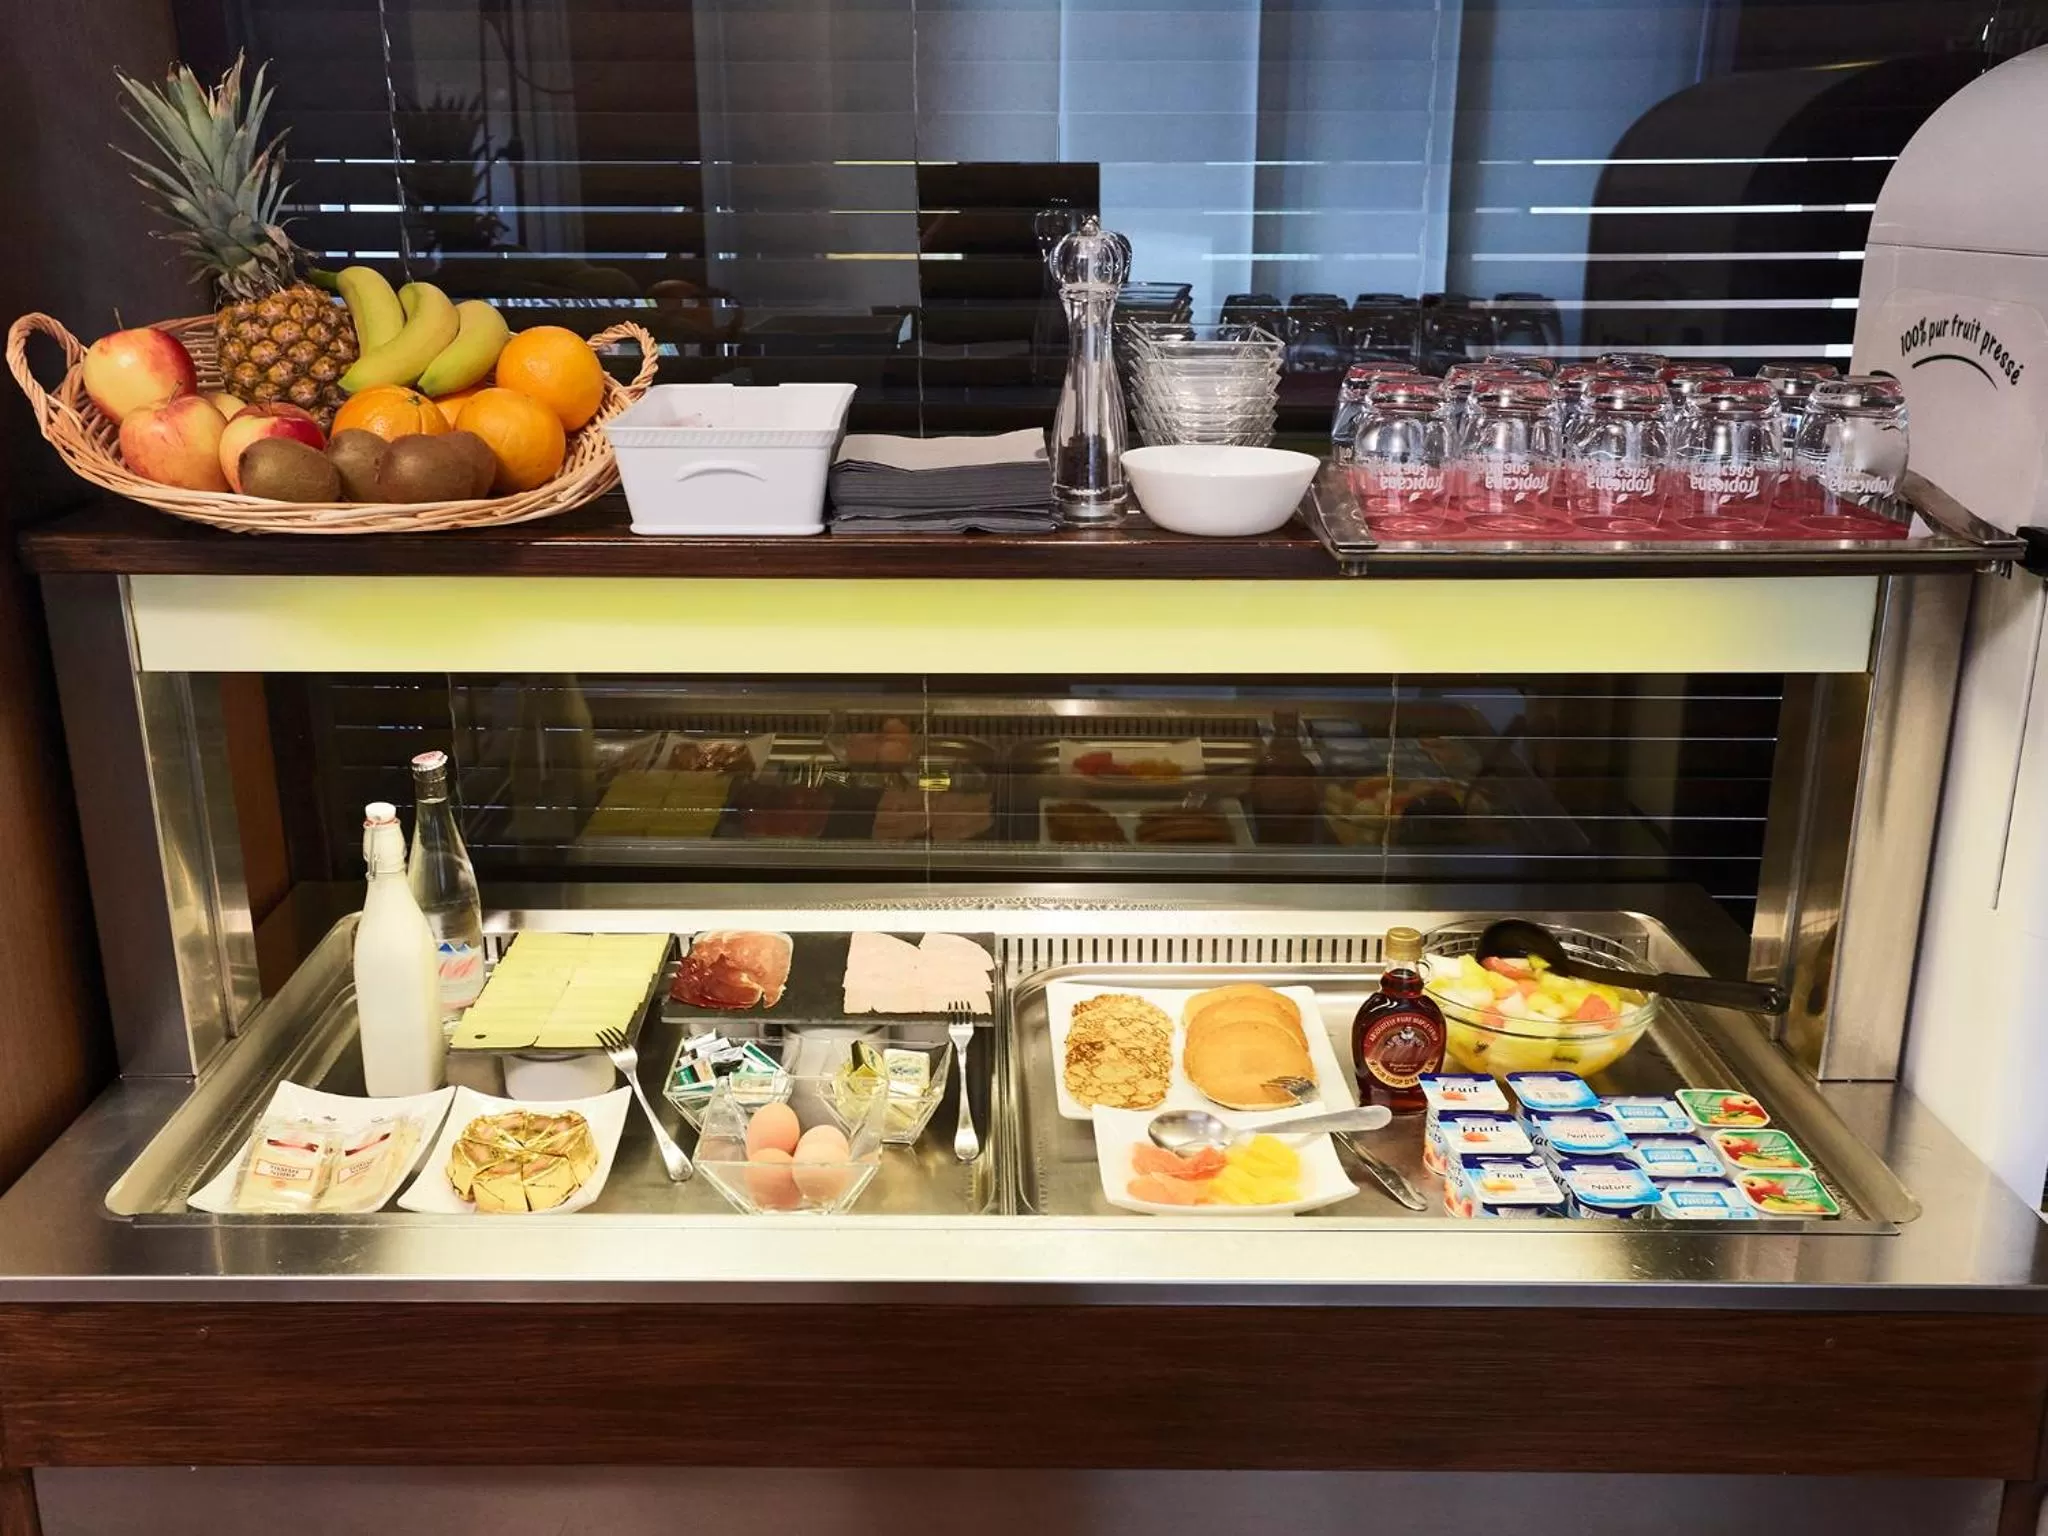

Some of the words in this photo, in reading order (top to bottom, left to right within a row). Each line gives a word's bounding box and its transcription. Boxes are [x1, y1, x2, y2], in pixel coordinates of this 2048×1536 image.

[1900, 317, 1927, 357] 100%
[1928, 318, 1950, 347] pur
[1951, 314, 1981, 344] fruit
[1979, 330, 2024, 386] pressé
[1380, 471, 1445, 495] Tropicana
[1586, 474, 1655, 497] Tropicana
[1689, 474, 1760, 499] Tropicana
[1829, 476, 1896, 499] Tropicana
